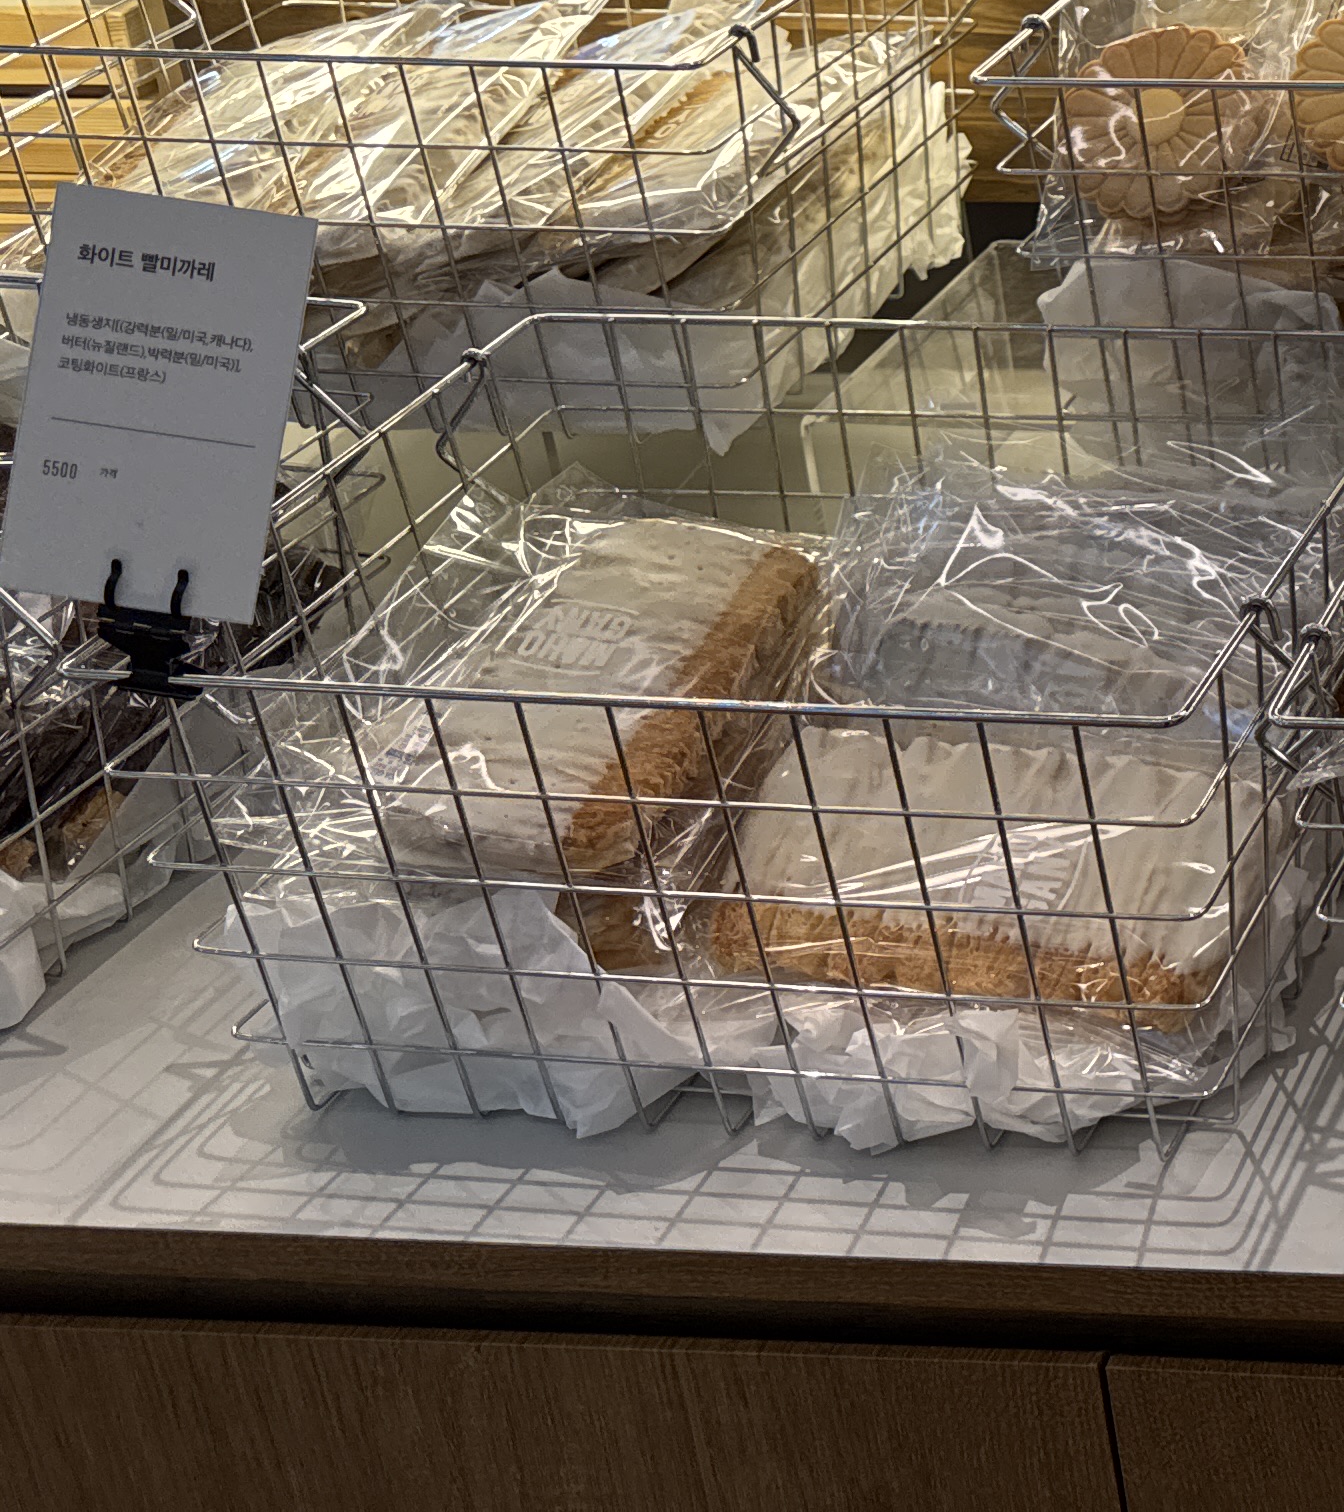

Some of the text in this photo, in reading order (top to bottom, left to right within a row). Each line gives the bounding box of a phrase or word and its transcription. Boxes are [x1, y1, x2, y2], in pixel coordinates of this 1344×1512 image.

[77, 242, 216, 282] 화이트 빨미까레
[42, 459, 78, 480] 5500
